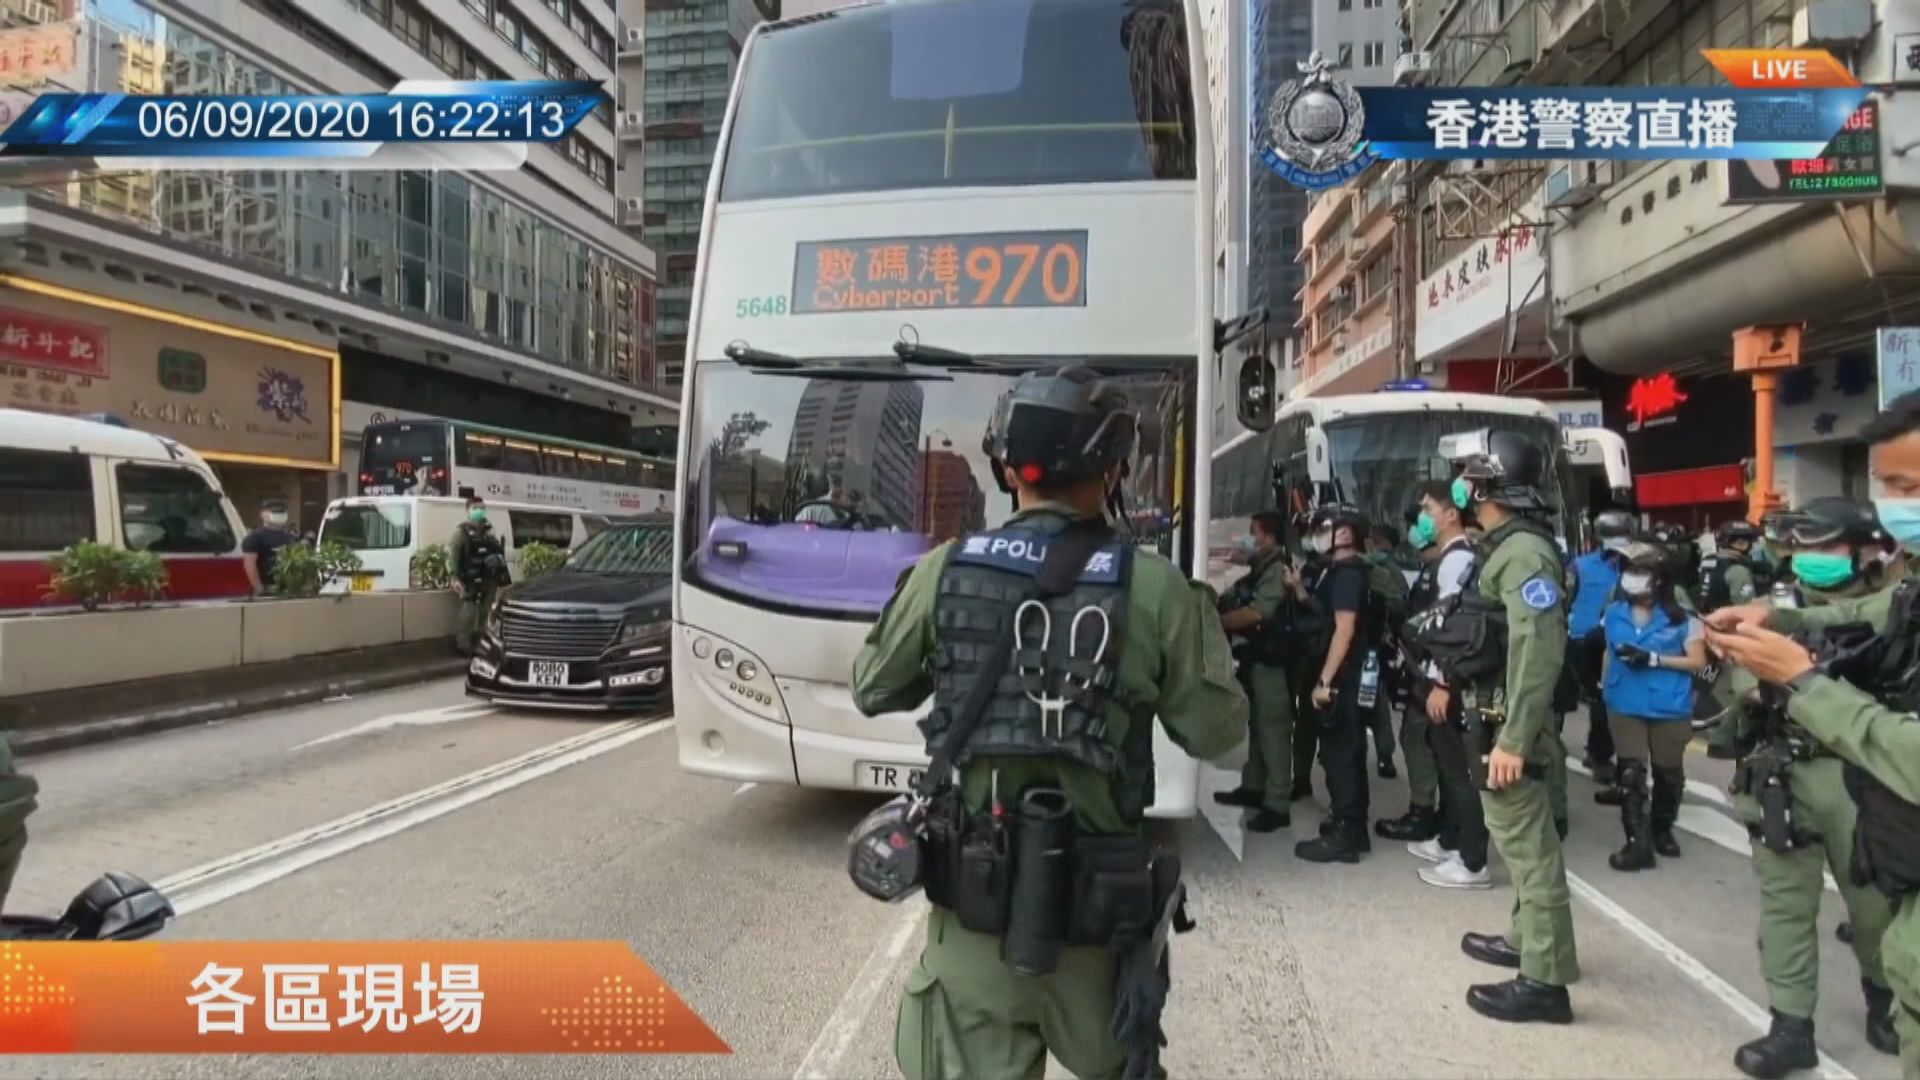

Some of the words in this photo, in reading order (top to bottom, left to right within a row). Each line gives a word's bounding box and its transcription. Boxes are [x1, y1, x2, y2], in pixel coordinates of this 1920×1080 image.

[816, 244, 958, 286] 數碼港
[965, 242, 1081, 305] 970
[735, 295, 787, 319] 5648
[813, 281, 959, 310] Cyberport
[991, 538, 1047, 562] POLI
[869, 765, 897, 787] TR
